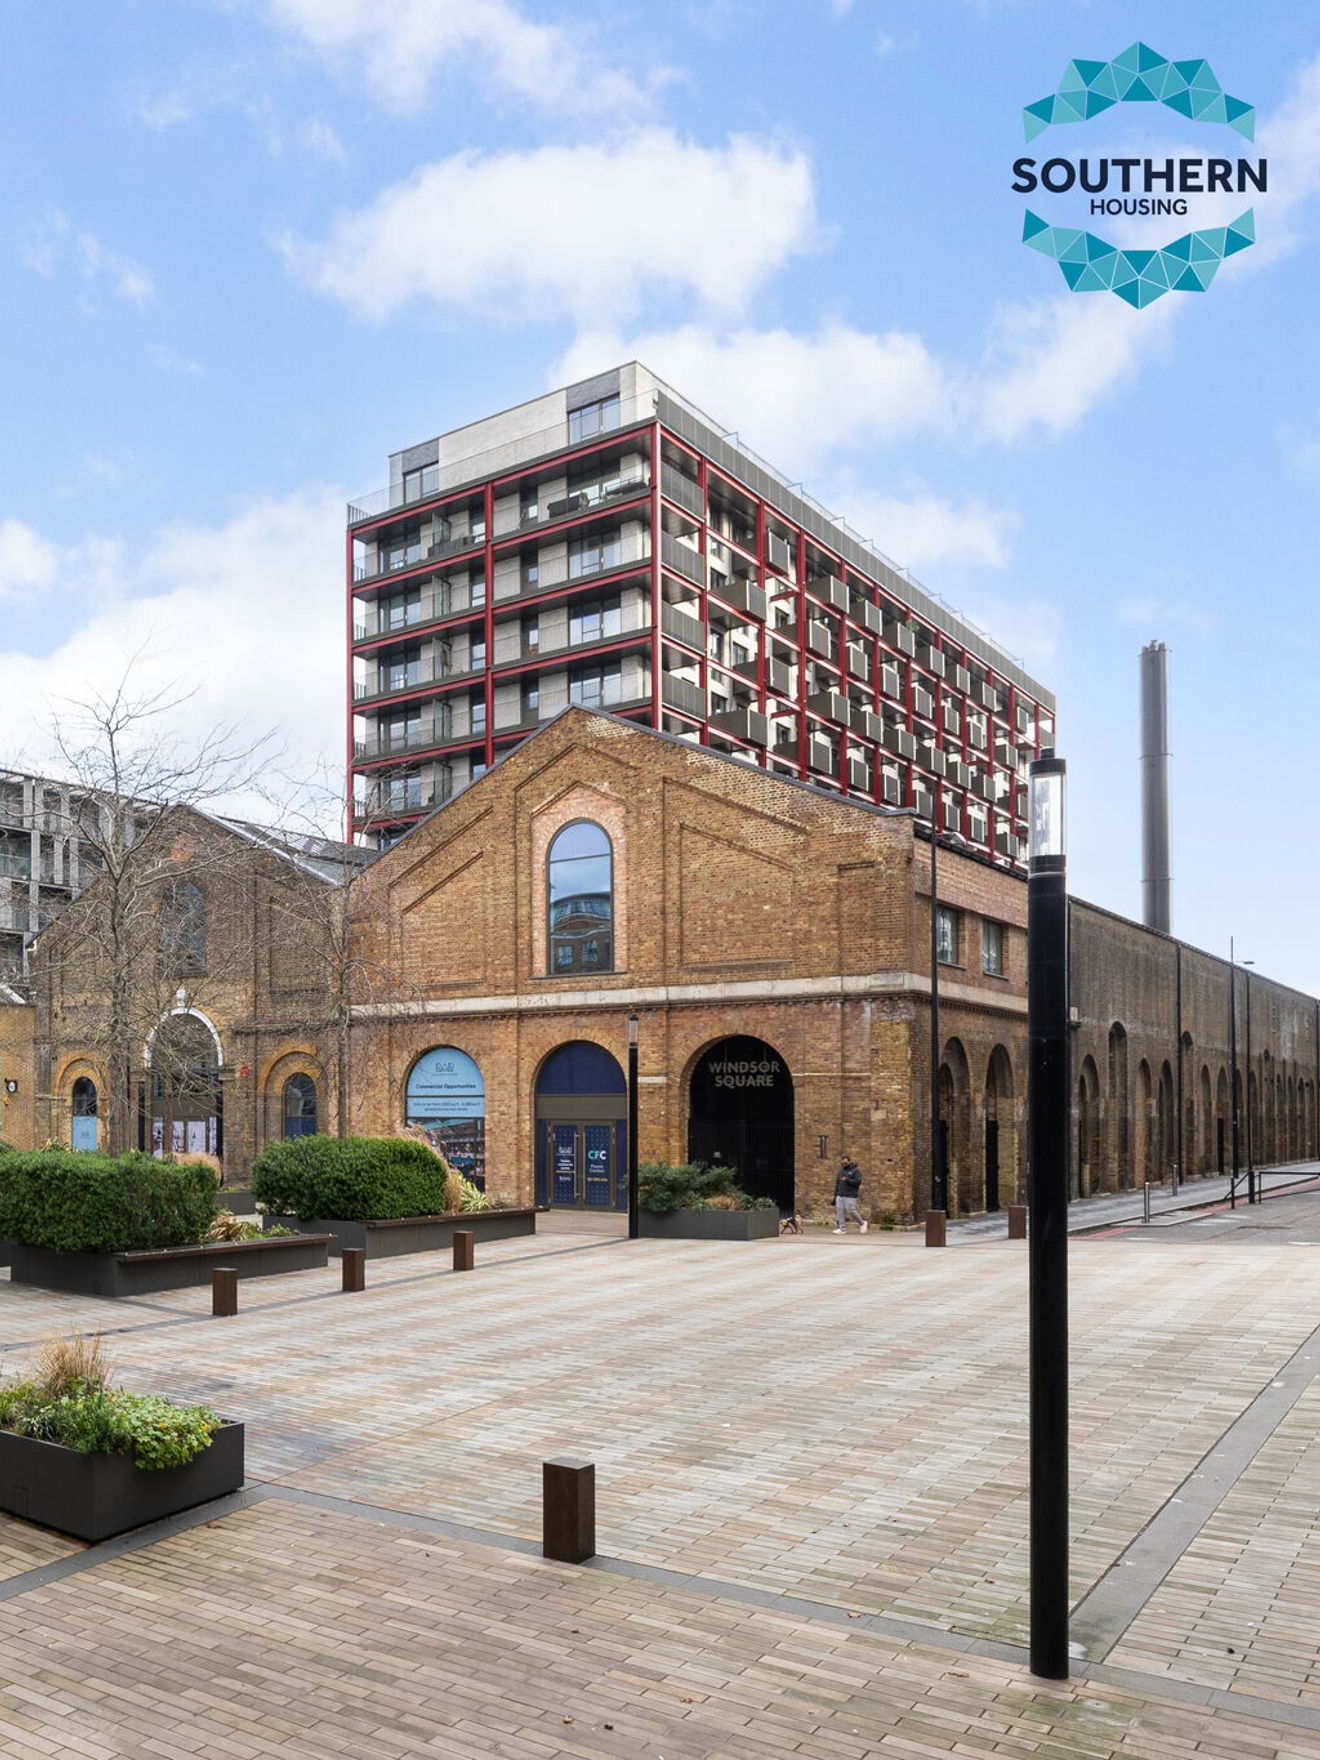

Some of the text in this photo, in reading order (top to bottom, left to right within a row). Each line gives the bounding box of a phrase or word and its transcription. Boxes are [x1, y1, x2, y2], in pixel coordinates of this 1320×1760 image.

[709, 1061, 781, 1074] WINDSOR
[714, 1075, 775, 1089] SQUARE
[588, 1150, 607, 1160] CFC
